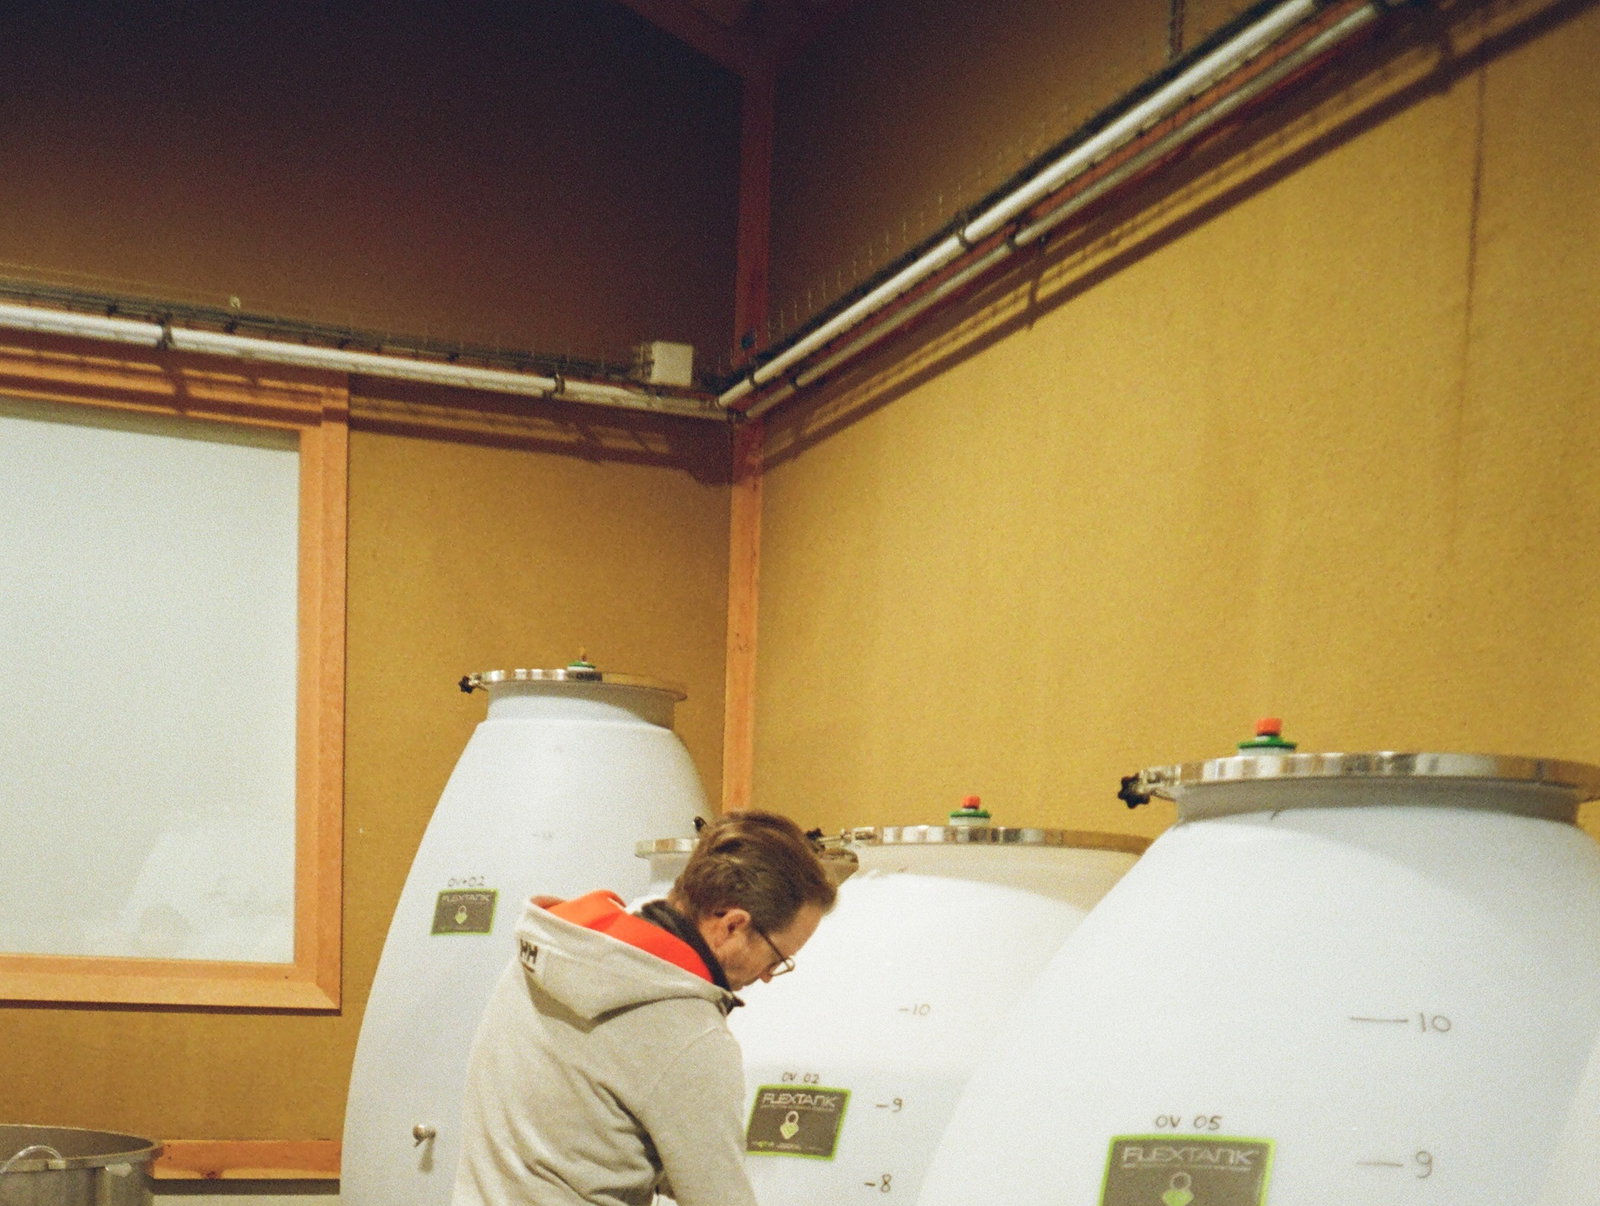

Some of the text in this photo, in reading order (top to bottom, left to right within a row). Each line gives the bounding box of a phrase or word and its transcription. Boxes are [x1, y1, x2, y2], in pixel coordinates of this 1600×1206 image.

[912, 1003, 931, 1017] 10
[1420, 1012, 1452, 1033] 10
[761, 1092, 839, 1108] FLEXTANK
[891, 1097, 904, 1113] 9
[1155, 1114, 1223, 1131] OV 05
[1121, 1146, 1257, 1165] FLEXTANK
[1415, 1150, 1433, 1179] 9
[880, 1173, 893, 1193] 8
